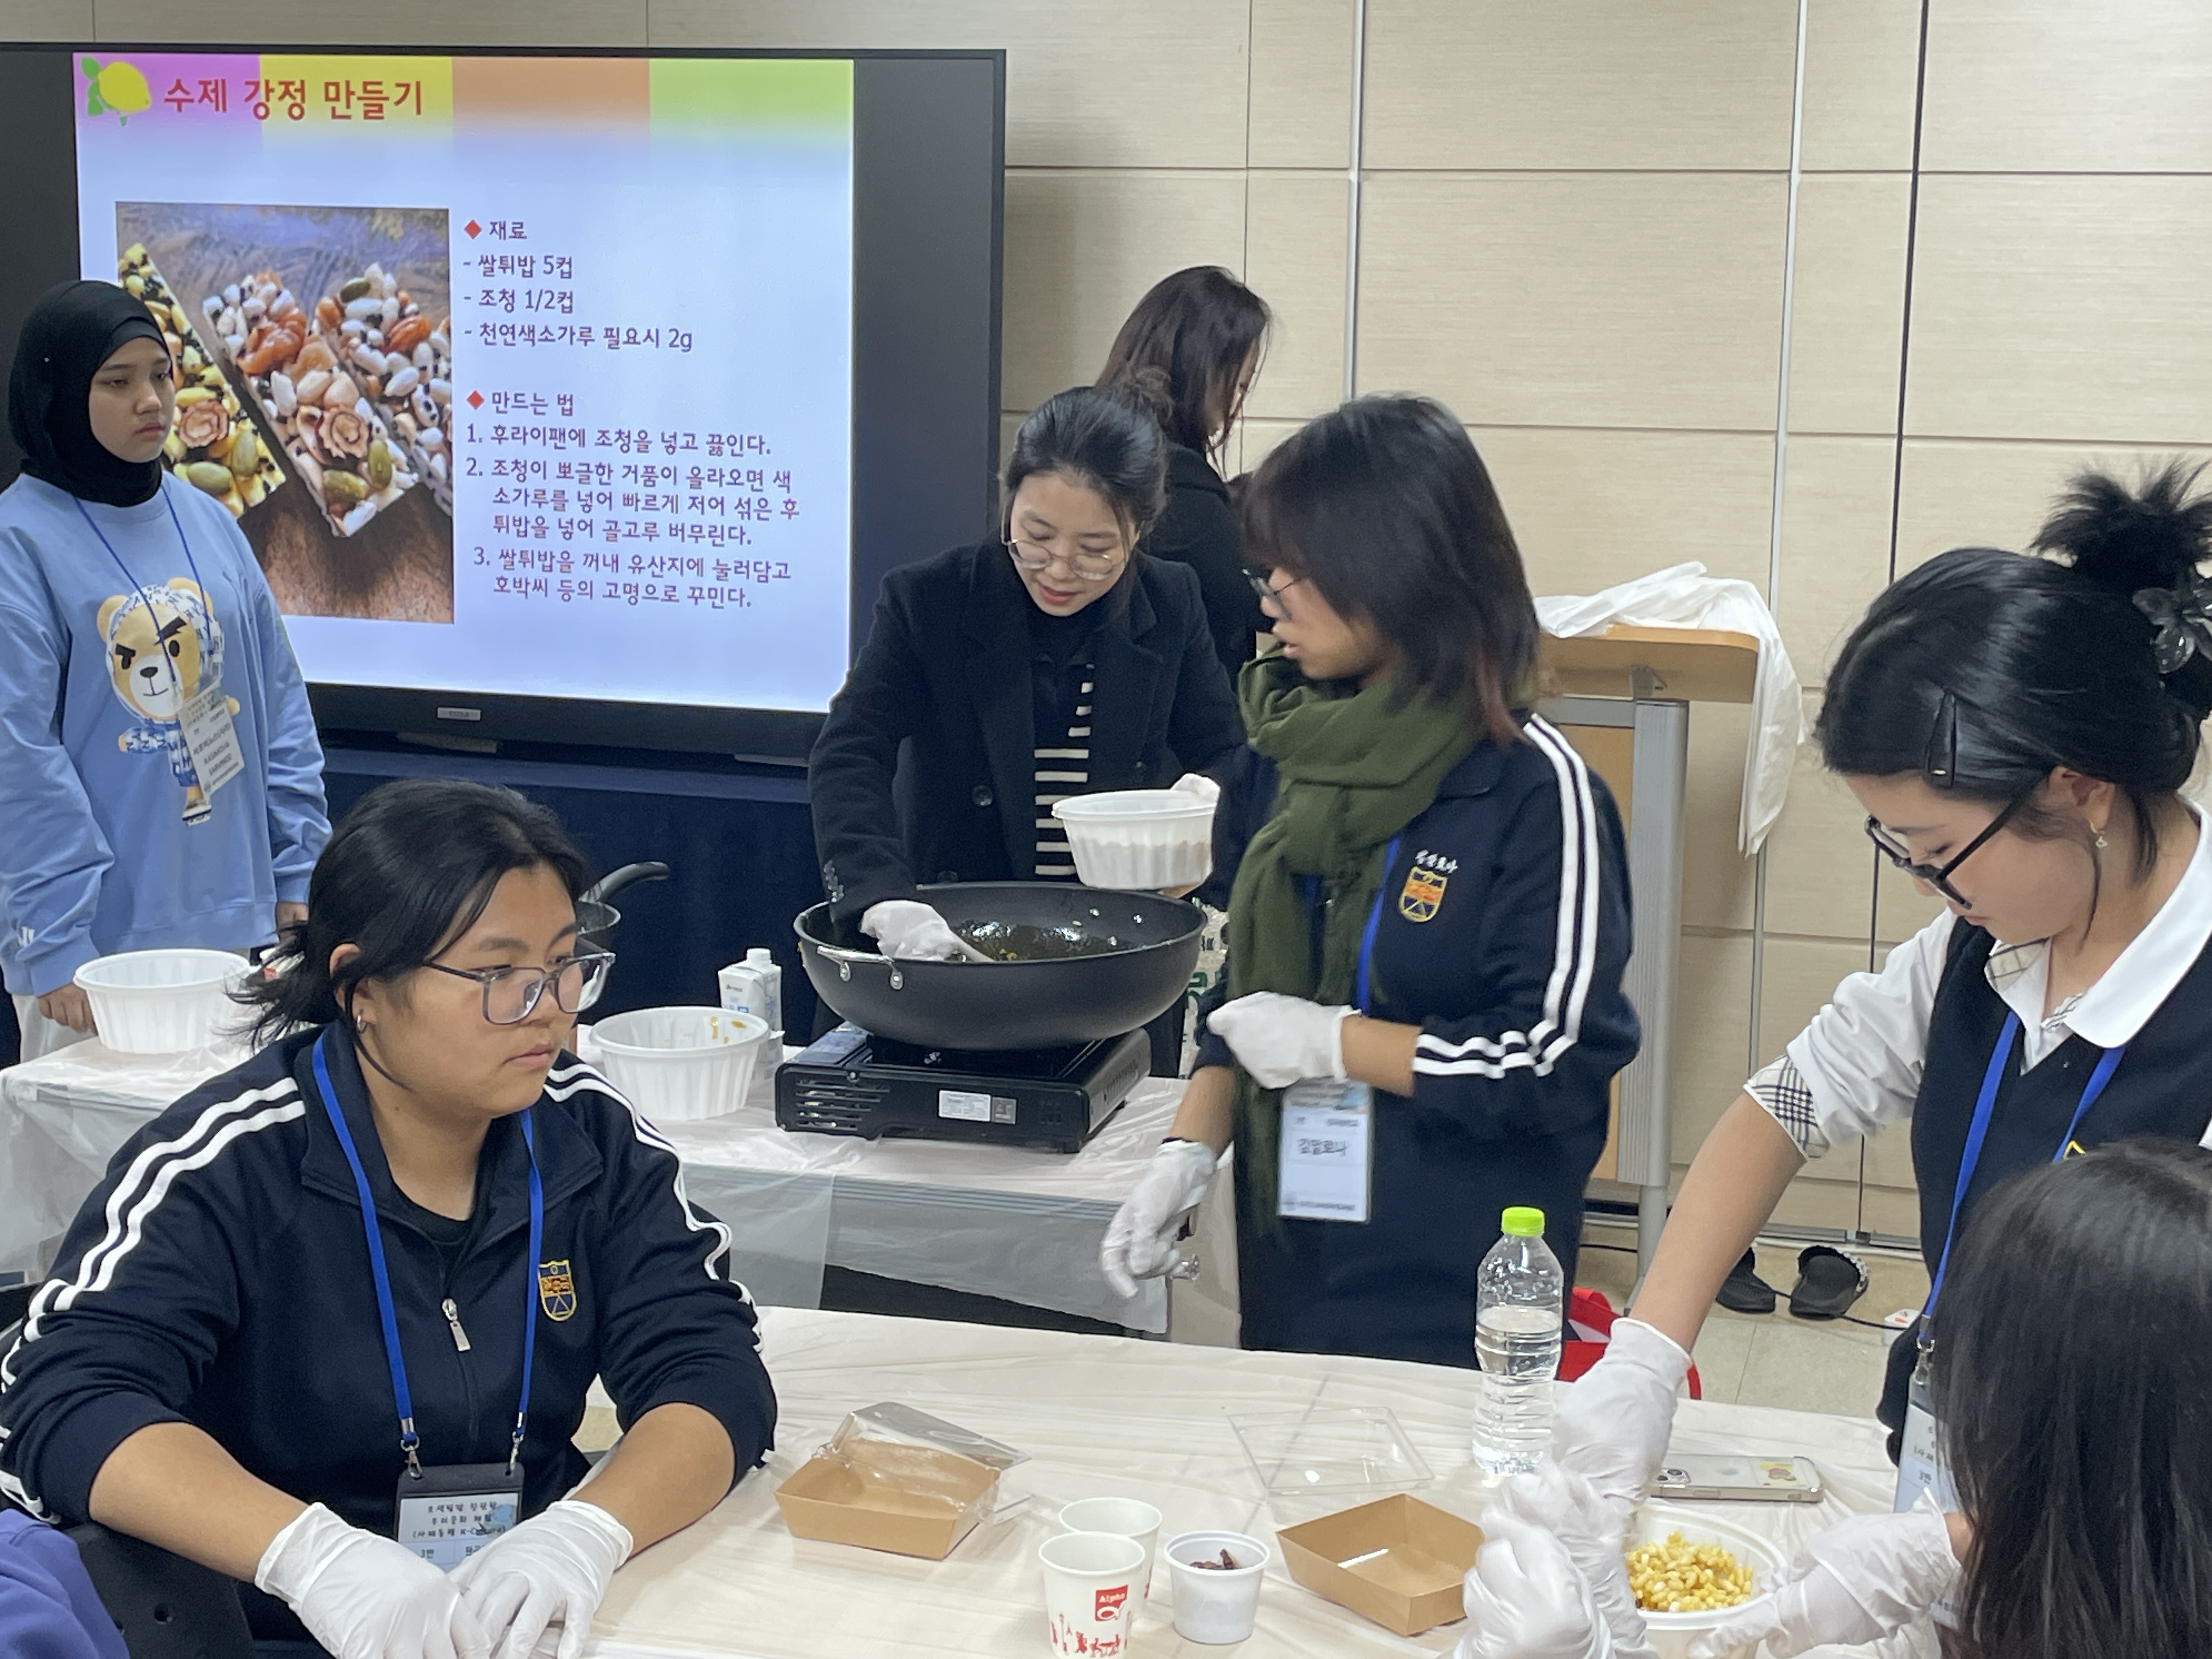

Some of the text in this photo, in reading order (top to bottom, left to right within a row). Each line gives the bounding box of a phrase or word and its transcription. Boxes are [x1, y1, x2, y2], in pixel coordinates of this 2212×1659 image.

[164, 79, 421, 121] 수제 강정 만들기
[489, 220, 527, 241] 재료
[478, 254, 536, 278] 쌀튀밥
[543, 255, 572, 279] 5컵
[478, 288, 515, 314] 조청
[525, 289, 573, 314] 1/2컵
[479, 322, 595, 347] 천연색소가루
[603, 326, 659, 350] 필요시
[668, 328, 692, 353] 2g
[492, 391, 574, 417] 만드는 법
[467, 423, 771, 458] 1. 후라이팬에 조청을 넣고 끓인다.
[466, 456, 791, 494] 2. 조청이 뽀글한 거품이 올라오면 색
[492, 487, 800, 521] 소가루를 넣어 빠르게 저어 섞은 후
[493, 515, 752, 548] 튀밥을 넣어 골고루 버무린다.
[474, 546, 791, 584] 3. 쌀튀밥을 꺼내 유산지에 눌러담고
[493, 575, 751, 610] 호박씨 등의 고명으로 꾸민다.
